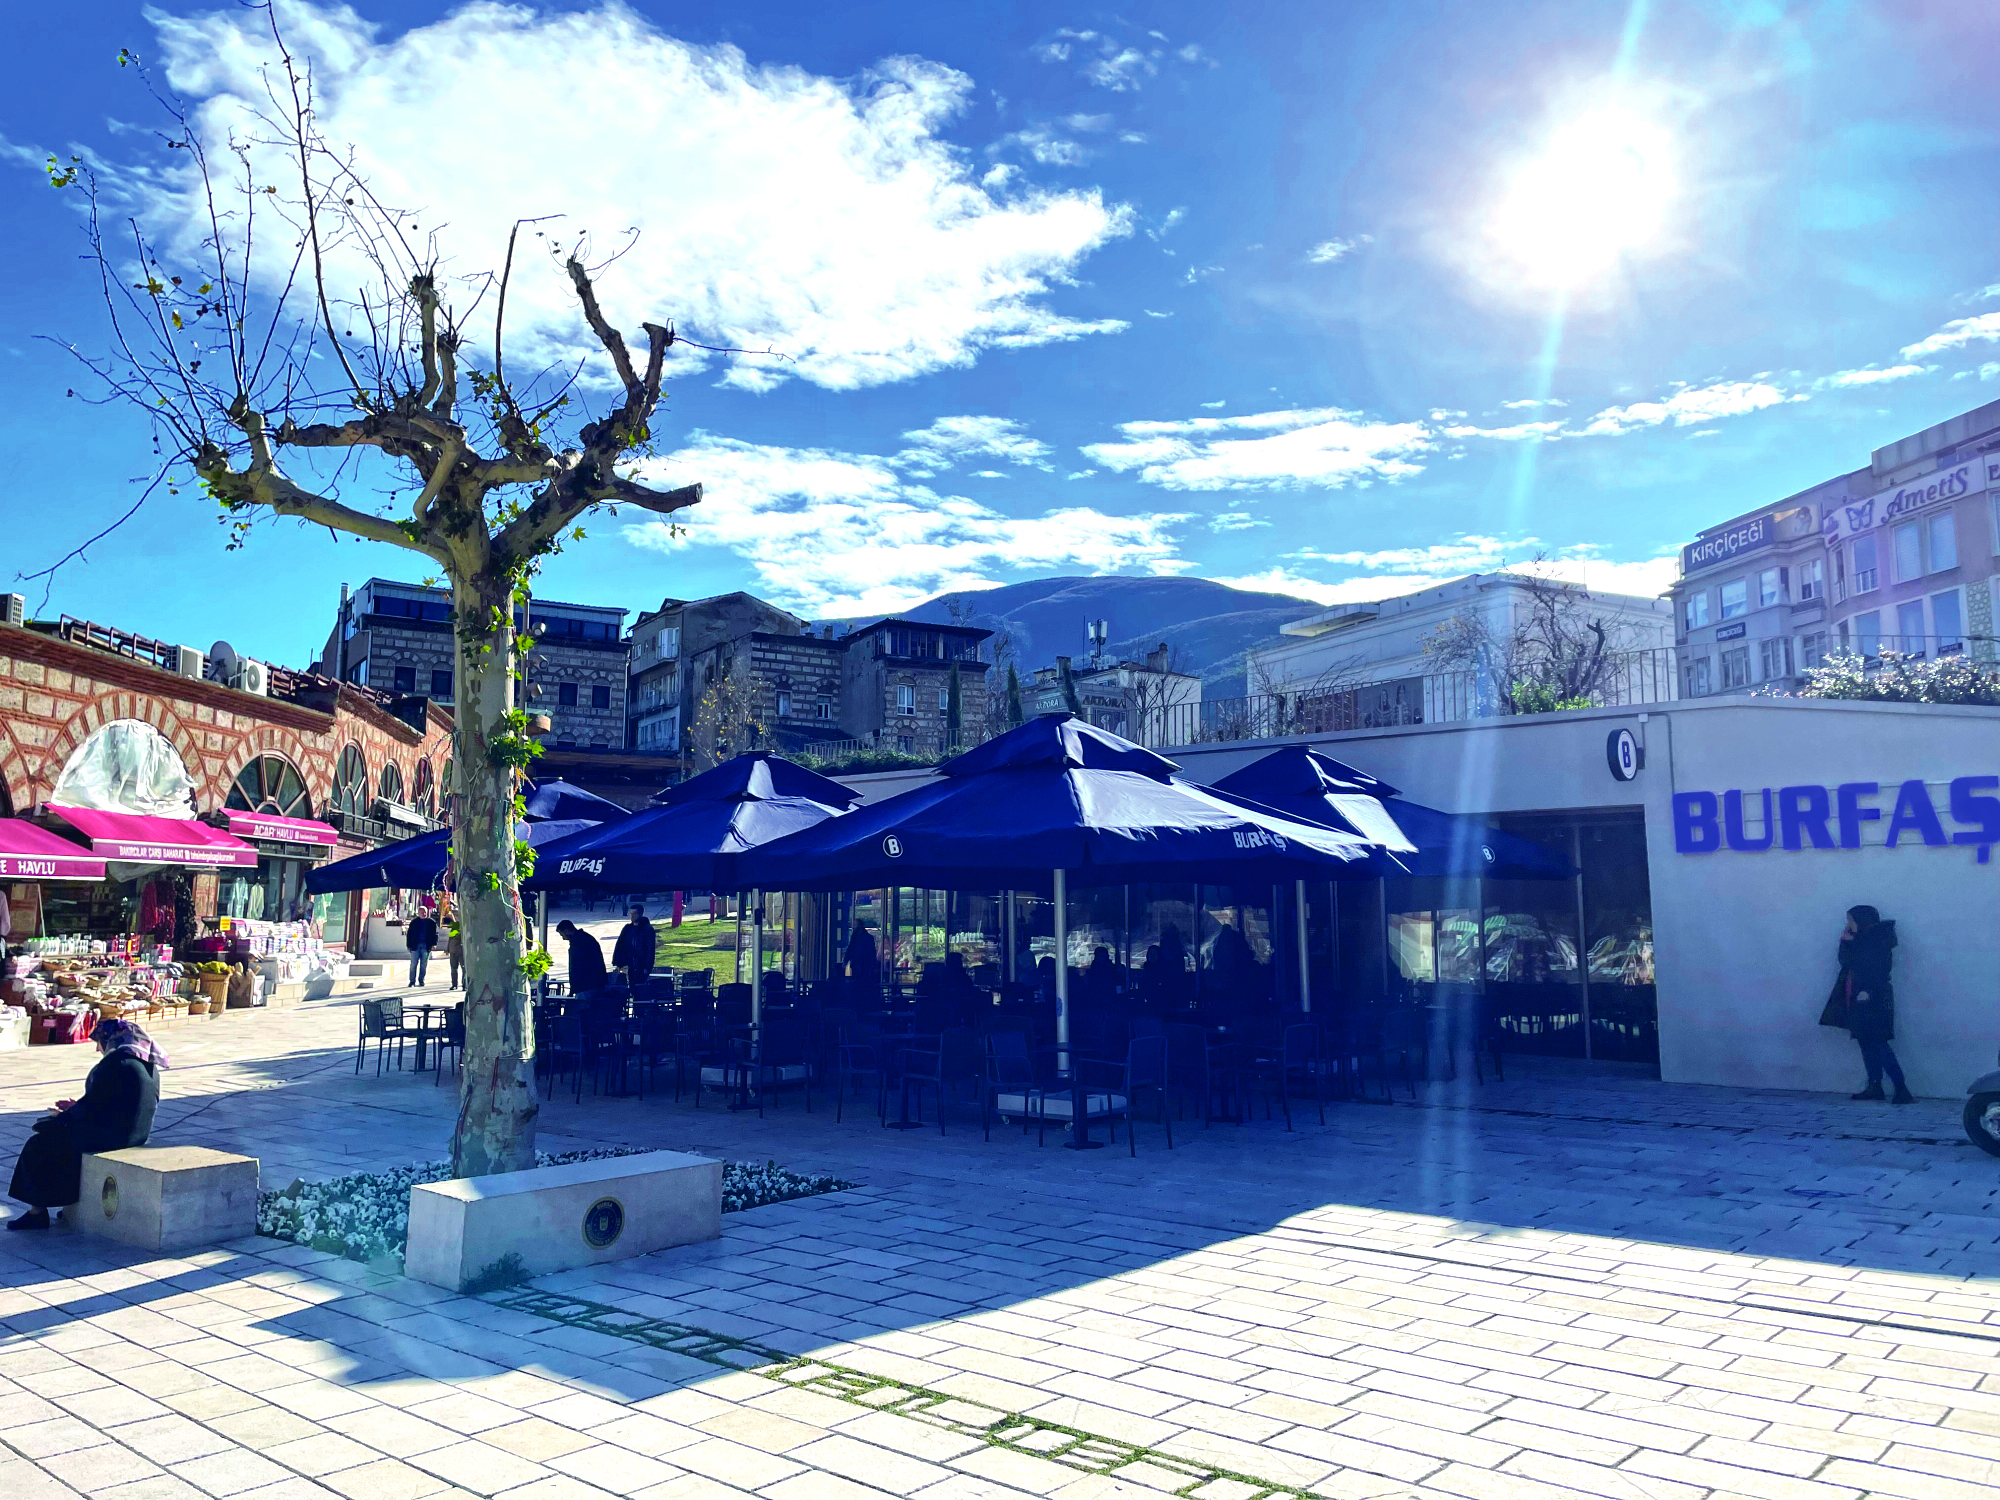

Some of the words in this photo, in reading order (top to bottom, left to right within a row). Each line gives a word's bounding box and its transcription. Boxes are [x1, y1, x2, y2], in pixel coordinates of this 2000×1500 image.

[1691, 520, 1764, 563] KIRÇİÇEĞİ
[1621, 741, 1632, 768] B
[1672, 775, 2000, 864] BURFAŞ
[253, 824, 275, 837] ACAR
[276, 827, 294, 839] HAVLU
[162, 848, 184, 859] BAHARAT
[887, 838, 900, 854] B
[17, 860, 56, 875] HAVLU
